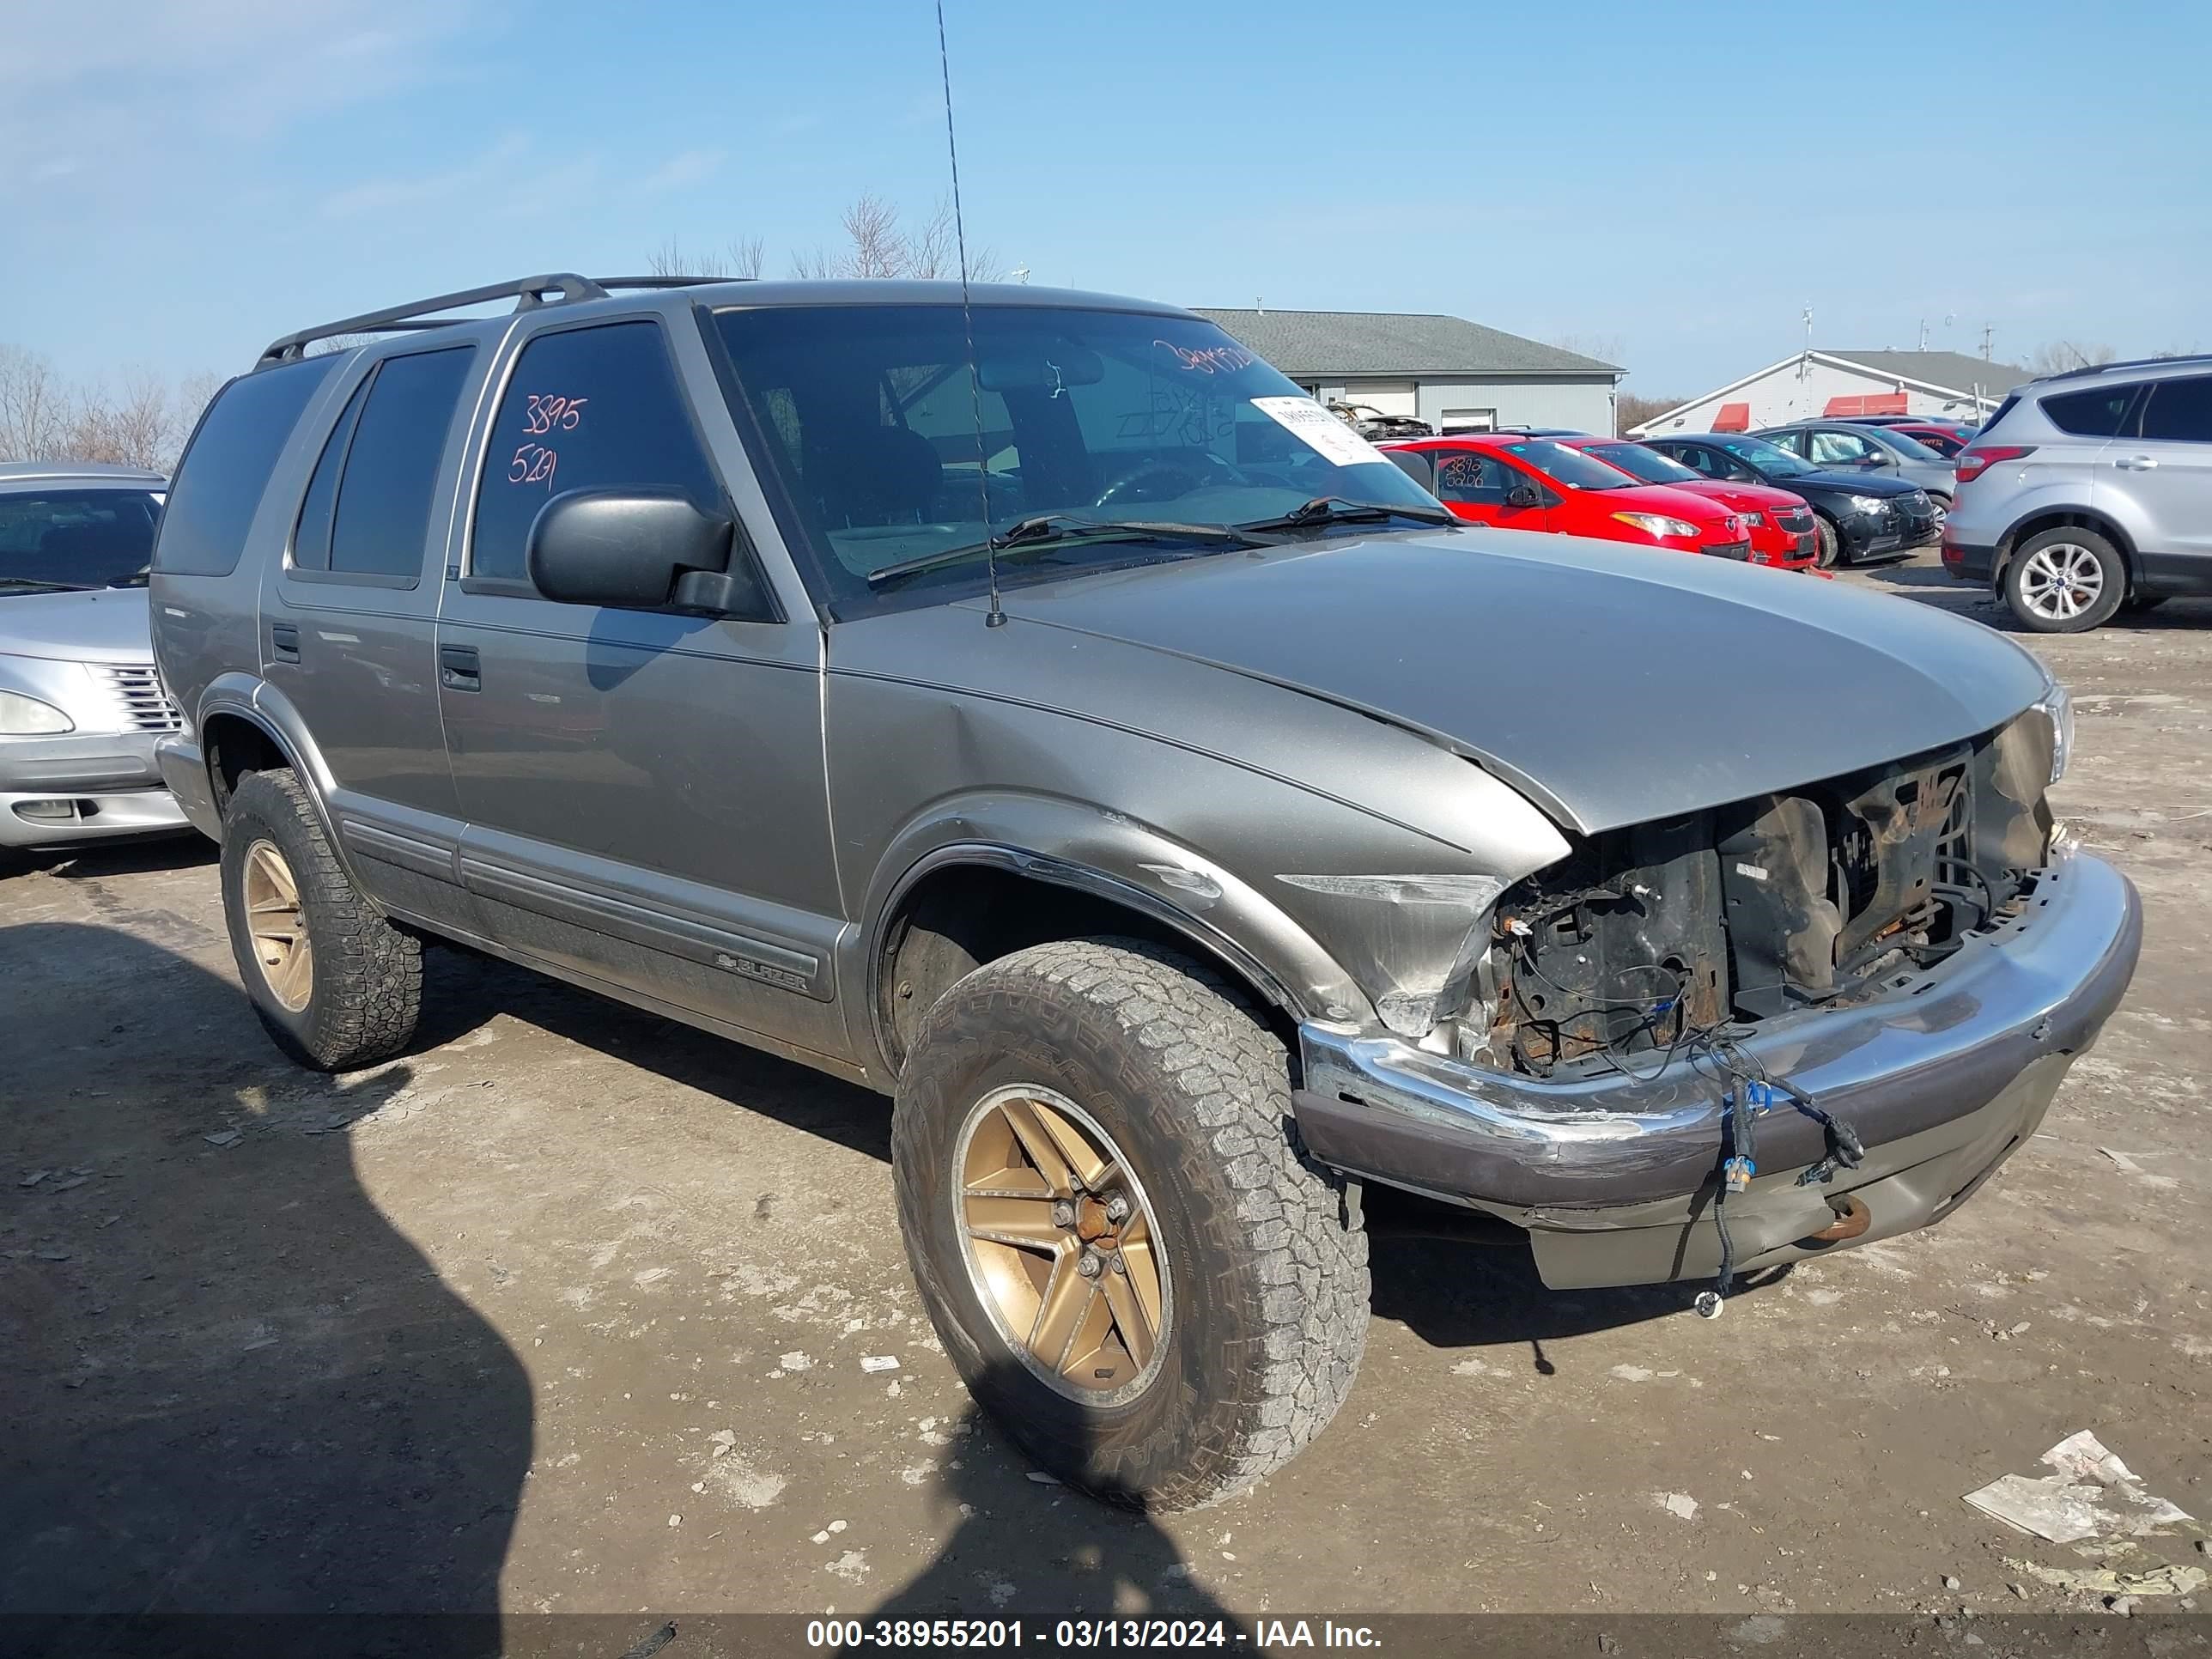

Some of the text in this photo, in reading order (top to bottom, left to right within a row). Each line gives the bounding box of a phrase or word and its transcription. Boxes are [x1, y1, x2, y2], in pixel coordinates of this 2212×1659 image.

[523, 394, 589, 434] 3895
[1446, 457, 1481, 472] 3892
[1446, 472, 1484, 488] 5206
[737, 958, 809, 990] BLAZER
